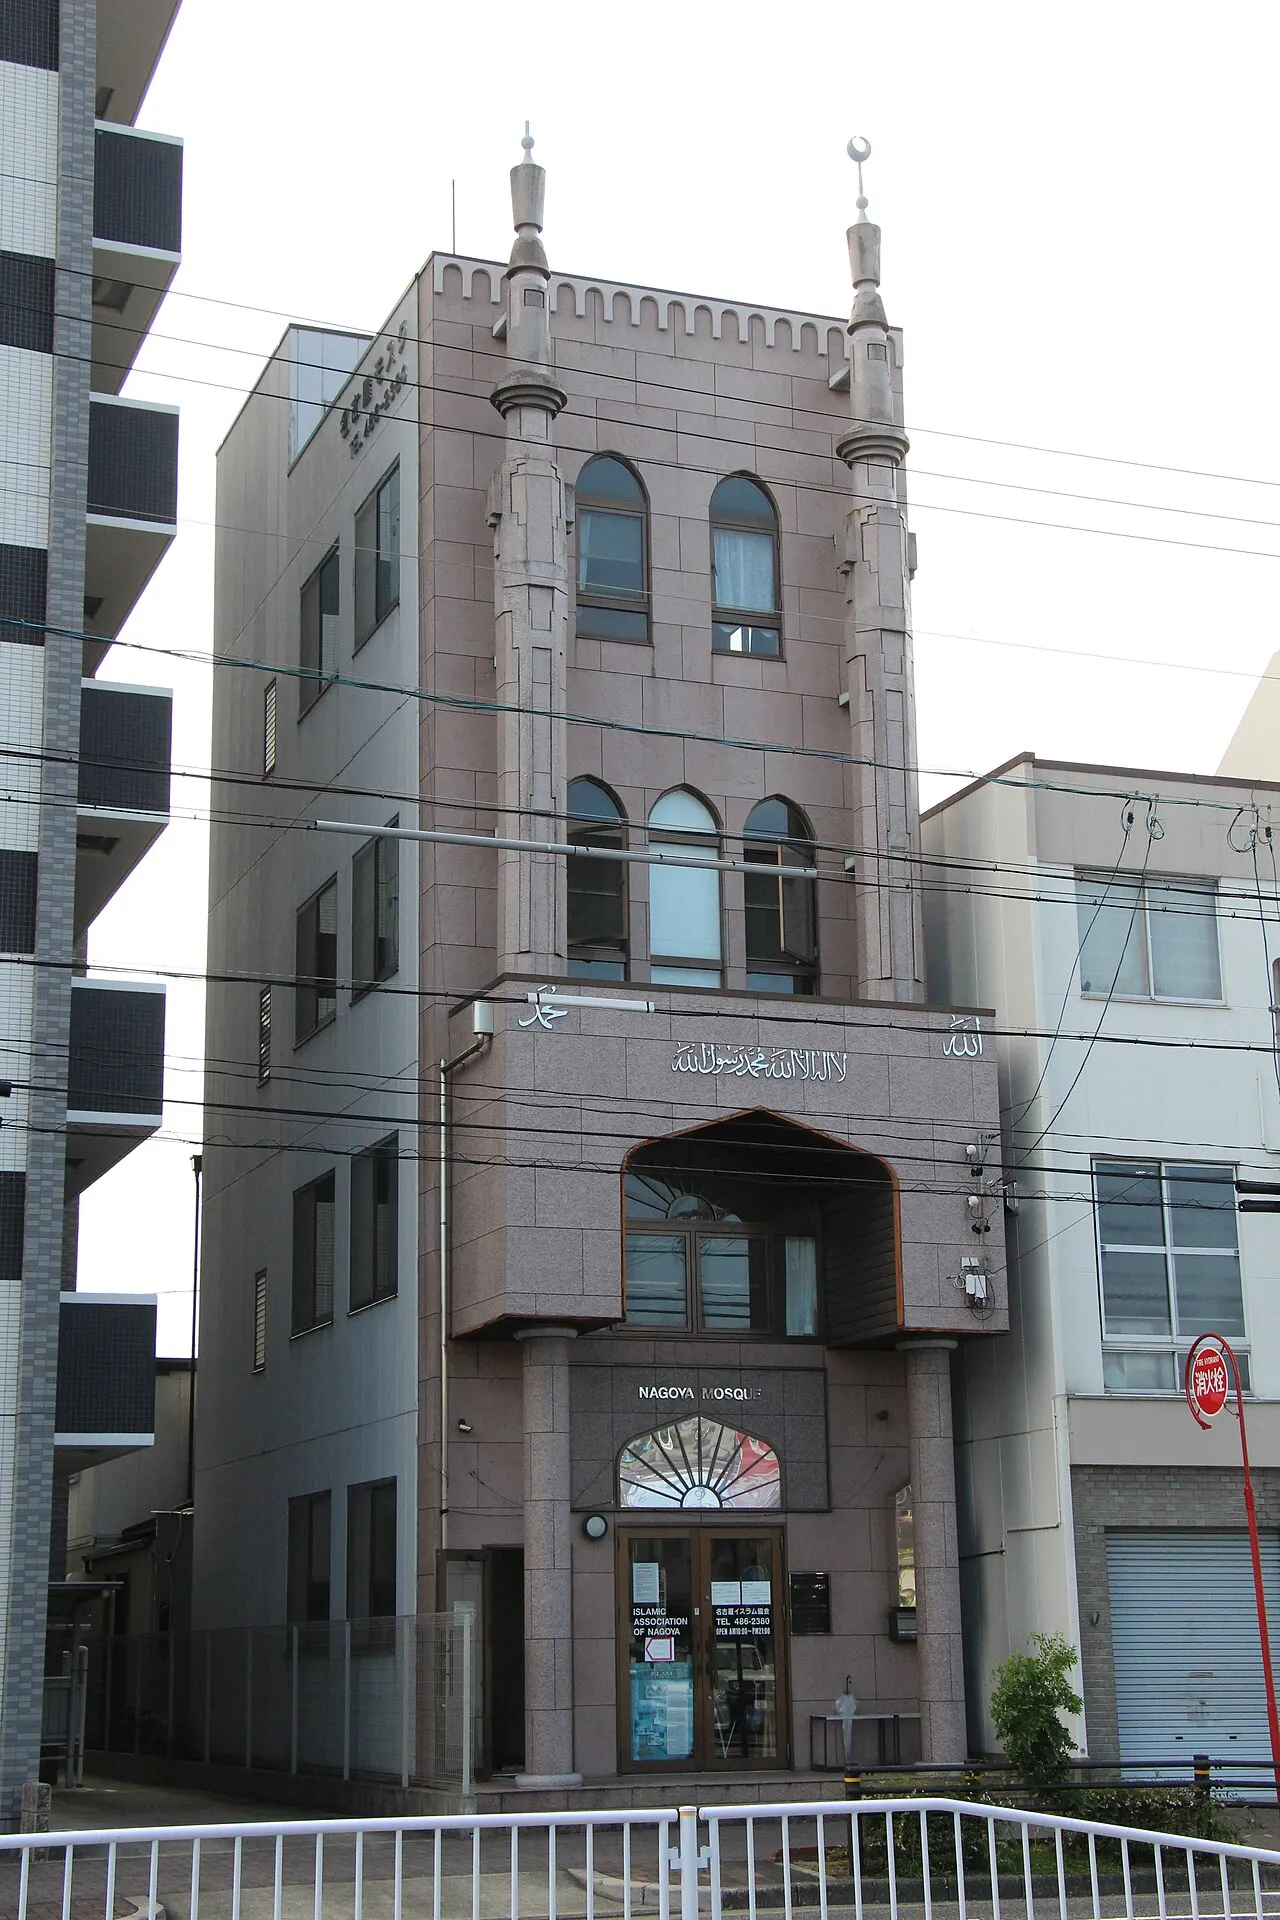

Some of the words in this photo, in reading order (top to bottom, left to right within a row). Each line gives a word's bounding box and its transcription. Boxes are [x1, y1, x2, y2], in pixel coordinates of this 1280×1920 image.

[942, 1014, 983, 1057] الله
[1195, 1367, 1224, 1396] 消火栓
[639, 1386, 695, 1399] NAGOYA
[702, 1387, 761, 1401] MOSQUE
[633, 1608, 667, 1616] ISLAMIC
[734, 1617, 770, 1625] 486-2380
[633, 1628, 645, 1636] OF
[647, 1627, 681, 1636] NAGOYA
[715, 1627, 728, 1636] OPEN
